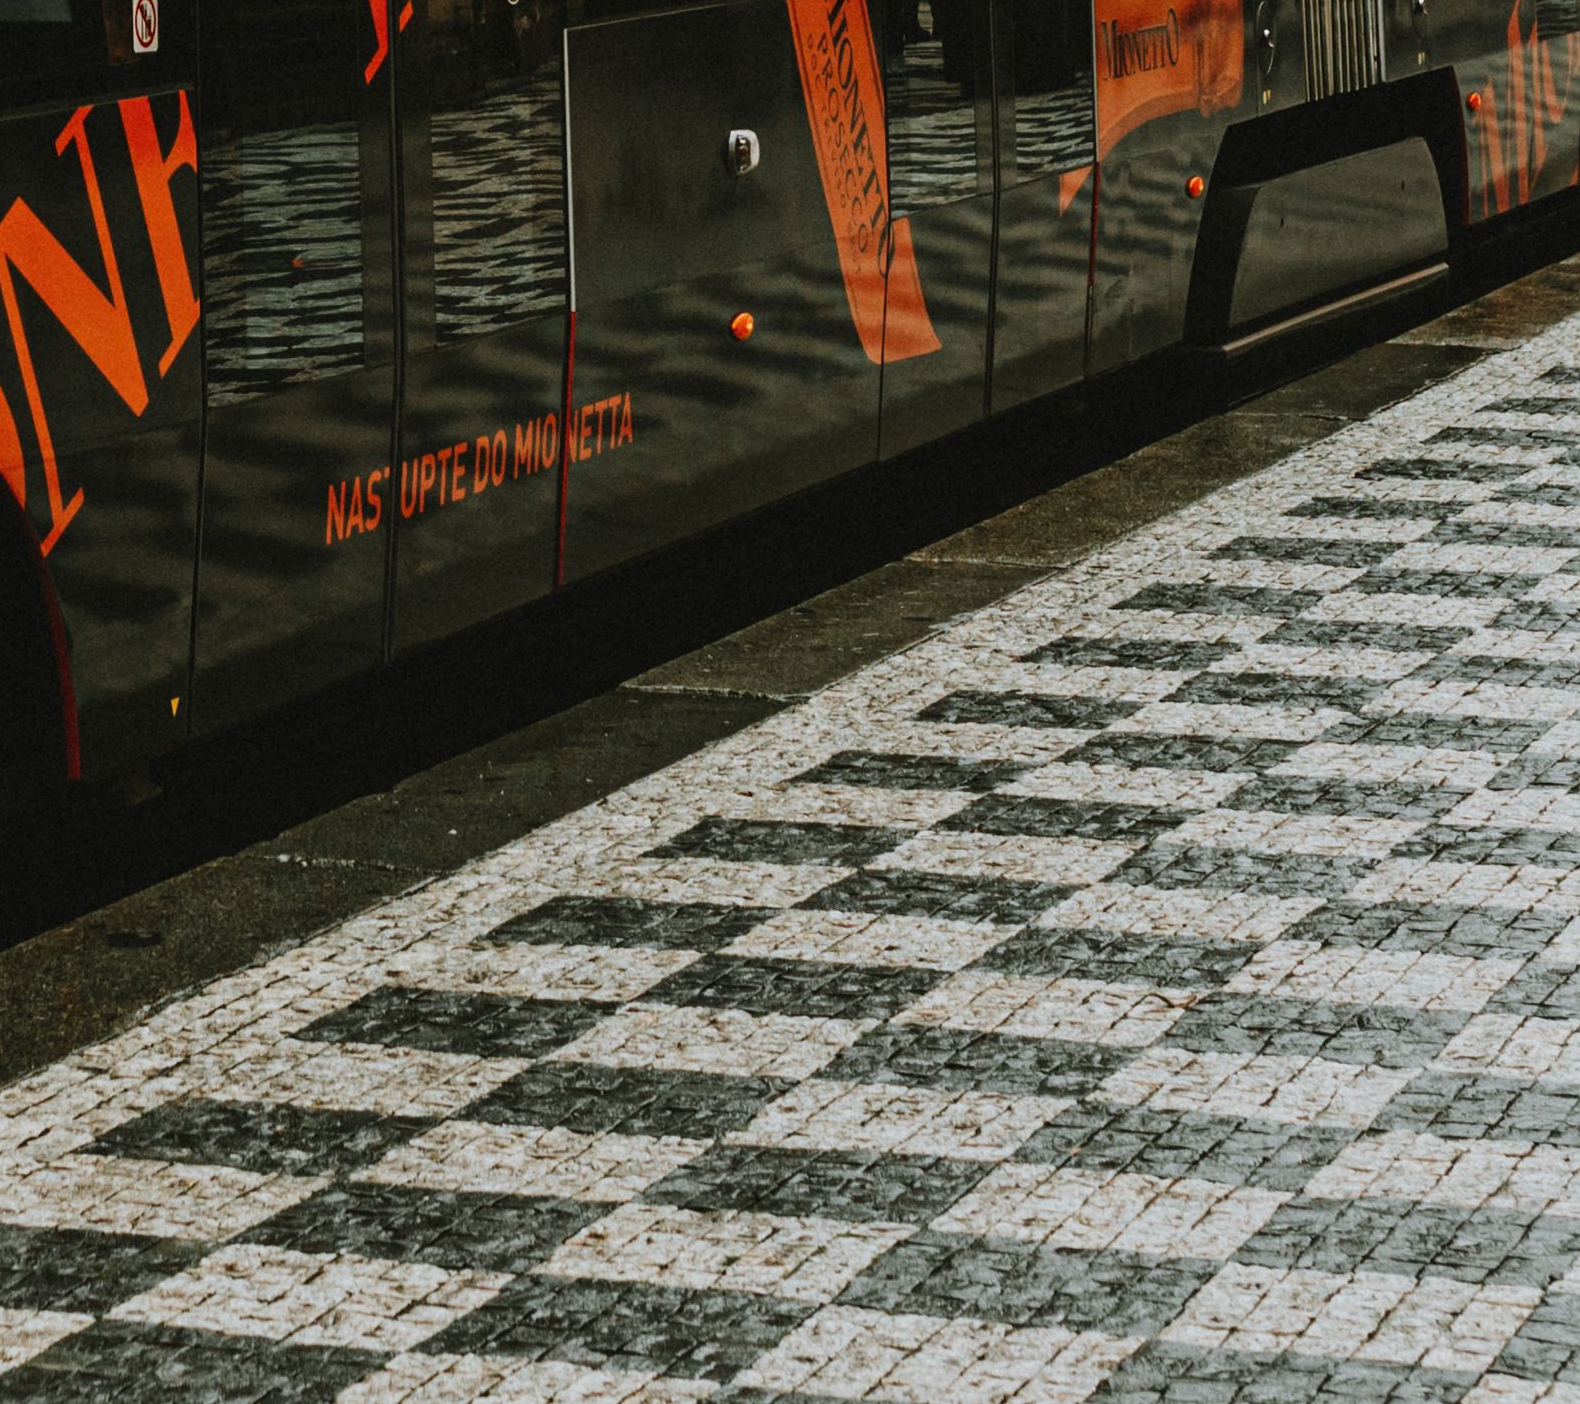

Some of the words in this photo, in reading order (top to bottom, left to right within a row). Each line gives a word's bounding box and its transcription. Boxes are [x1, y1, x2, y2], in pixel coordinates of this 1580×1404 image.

[1100, 7, 1180, 82] MIONETTO
[815, 31, 870, 254] PROSECCO
[472, 428, 508, 494] DO
